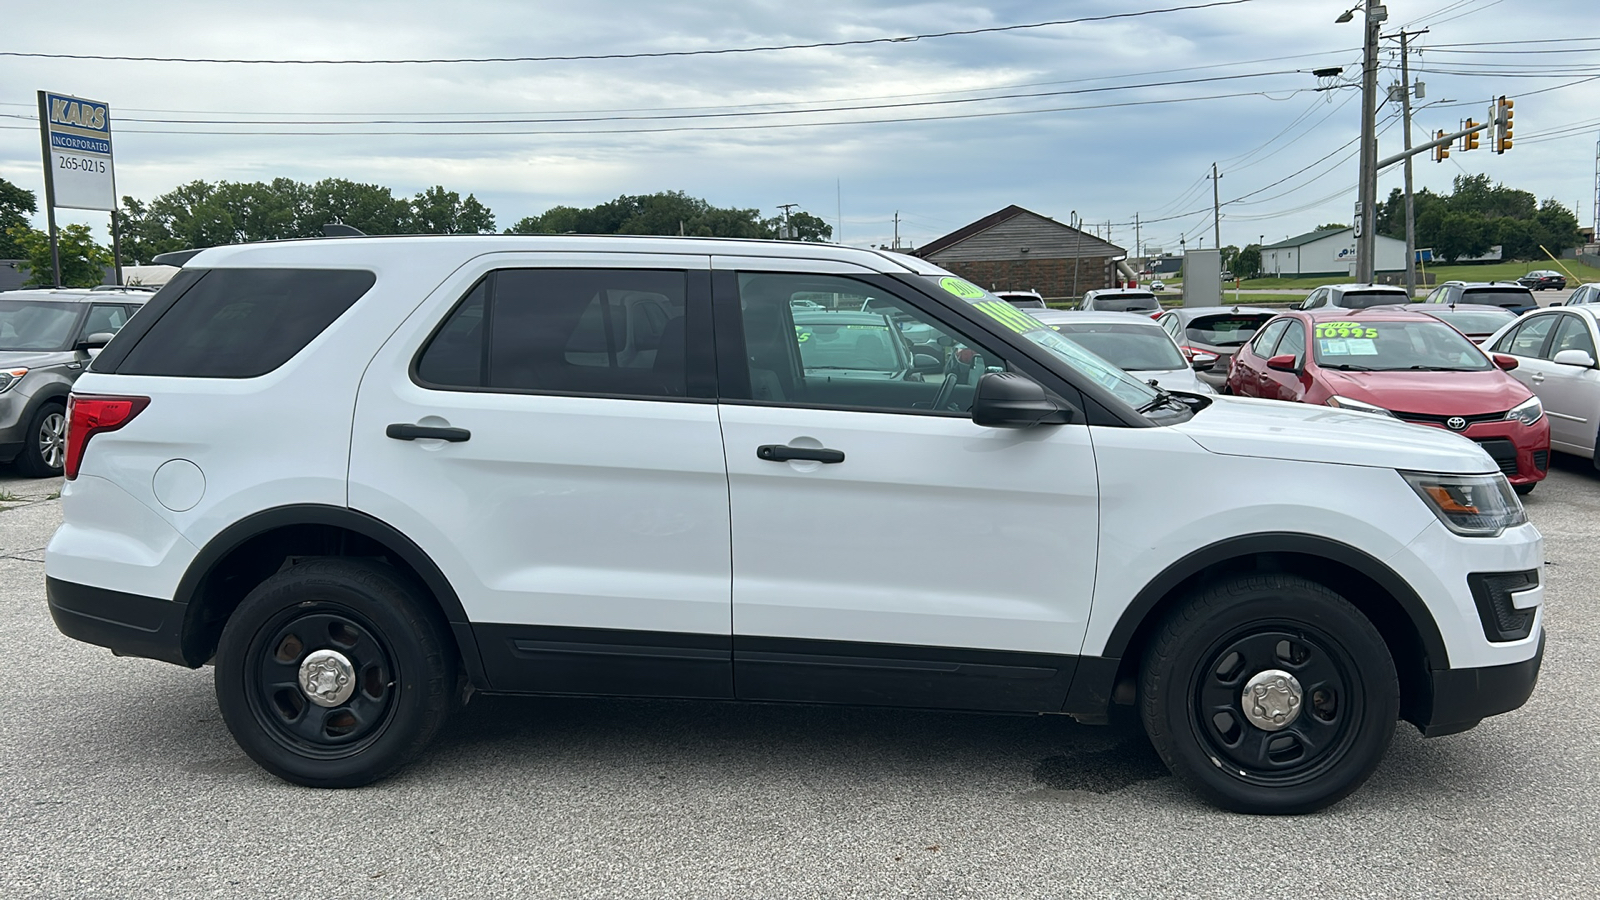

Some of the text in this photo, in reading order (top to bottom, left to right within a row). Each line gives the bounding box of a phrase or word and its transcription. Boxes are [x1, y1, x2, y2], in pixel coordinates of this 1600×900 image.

[51, 98, 105, 129] KARS
[52, 136, 108, 151] INCORPORATED
[60, 156, 105, 173] 265-0215
[1315, 328, 1378, 338] 10995
